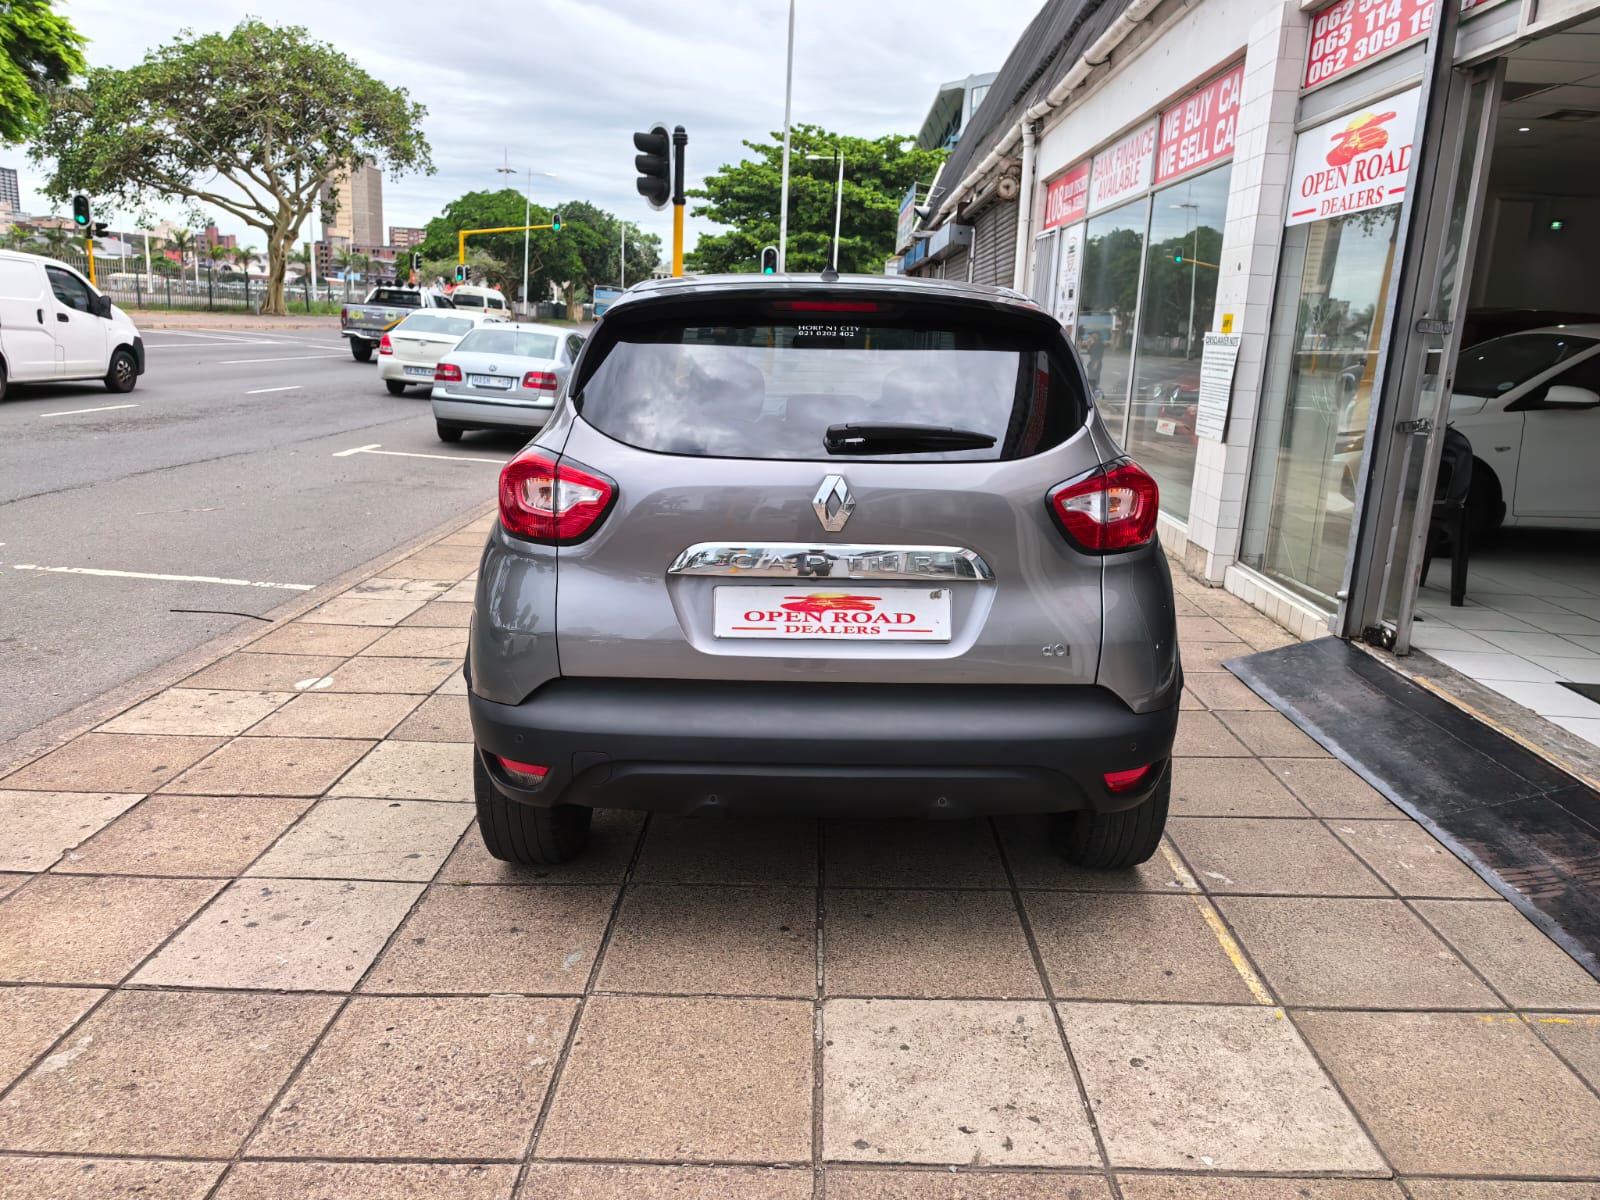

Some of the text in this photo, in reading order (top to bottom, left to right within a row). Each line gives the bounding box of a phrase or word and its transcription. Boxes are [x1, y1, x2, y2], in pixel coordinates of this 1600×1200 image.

[1312, 0, 1402, 61] 063 114
[1315, 0, 1354, 38] 062
[1308, 48, 1348, 84] 062
[1352, 21, 1401, 62] 309
[1163, 109, 1181, 145] WE
[1184, 87, 1215, 133] BUY
[1117, 127, 1156, 161] FINANCE
[1159, 143, 1177, 179] WE
[1178, 128, 1209, 170] SELL
[1097, 160, 1141, 202] AVAILABLE
[1301, 144, 1413, 198] OPEN ROAD
[1320, 185, 1384, 216] DEALERS
[730, 553, 934, 573] CAPTUR
[743, 610, 916, 624] OPEN ROAD
[784, 624, 881, 635] DEALERS
